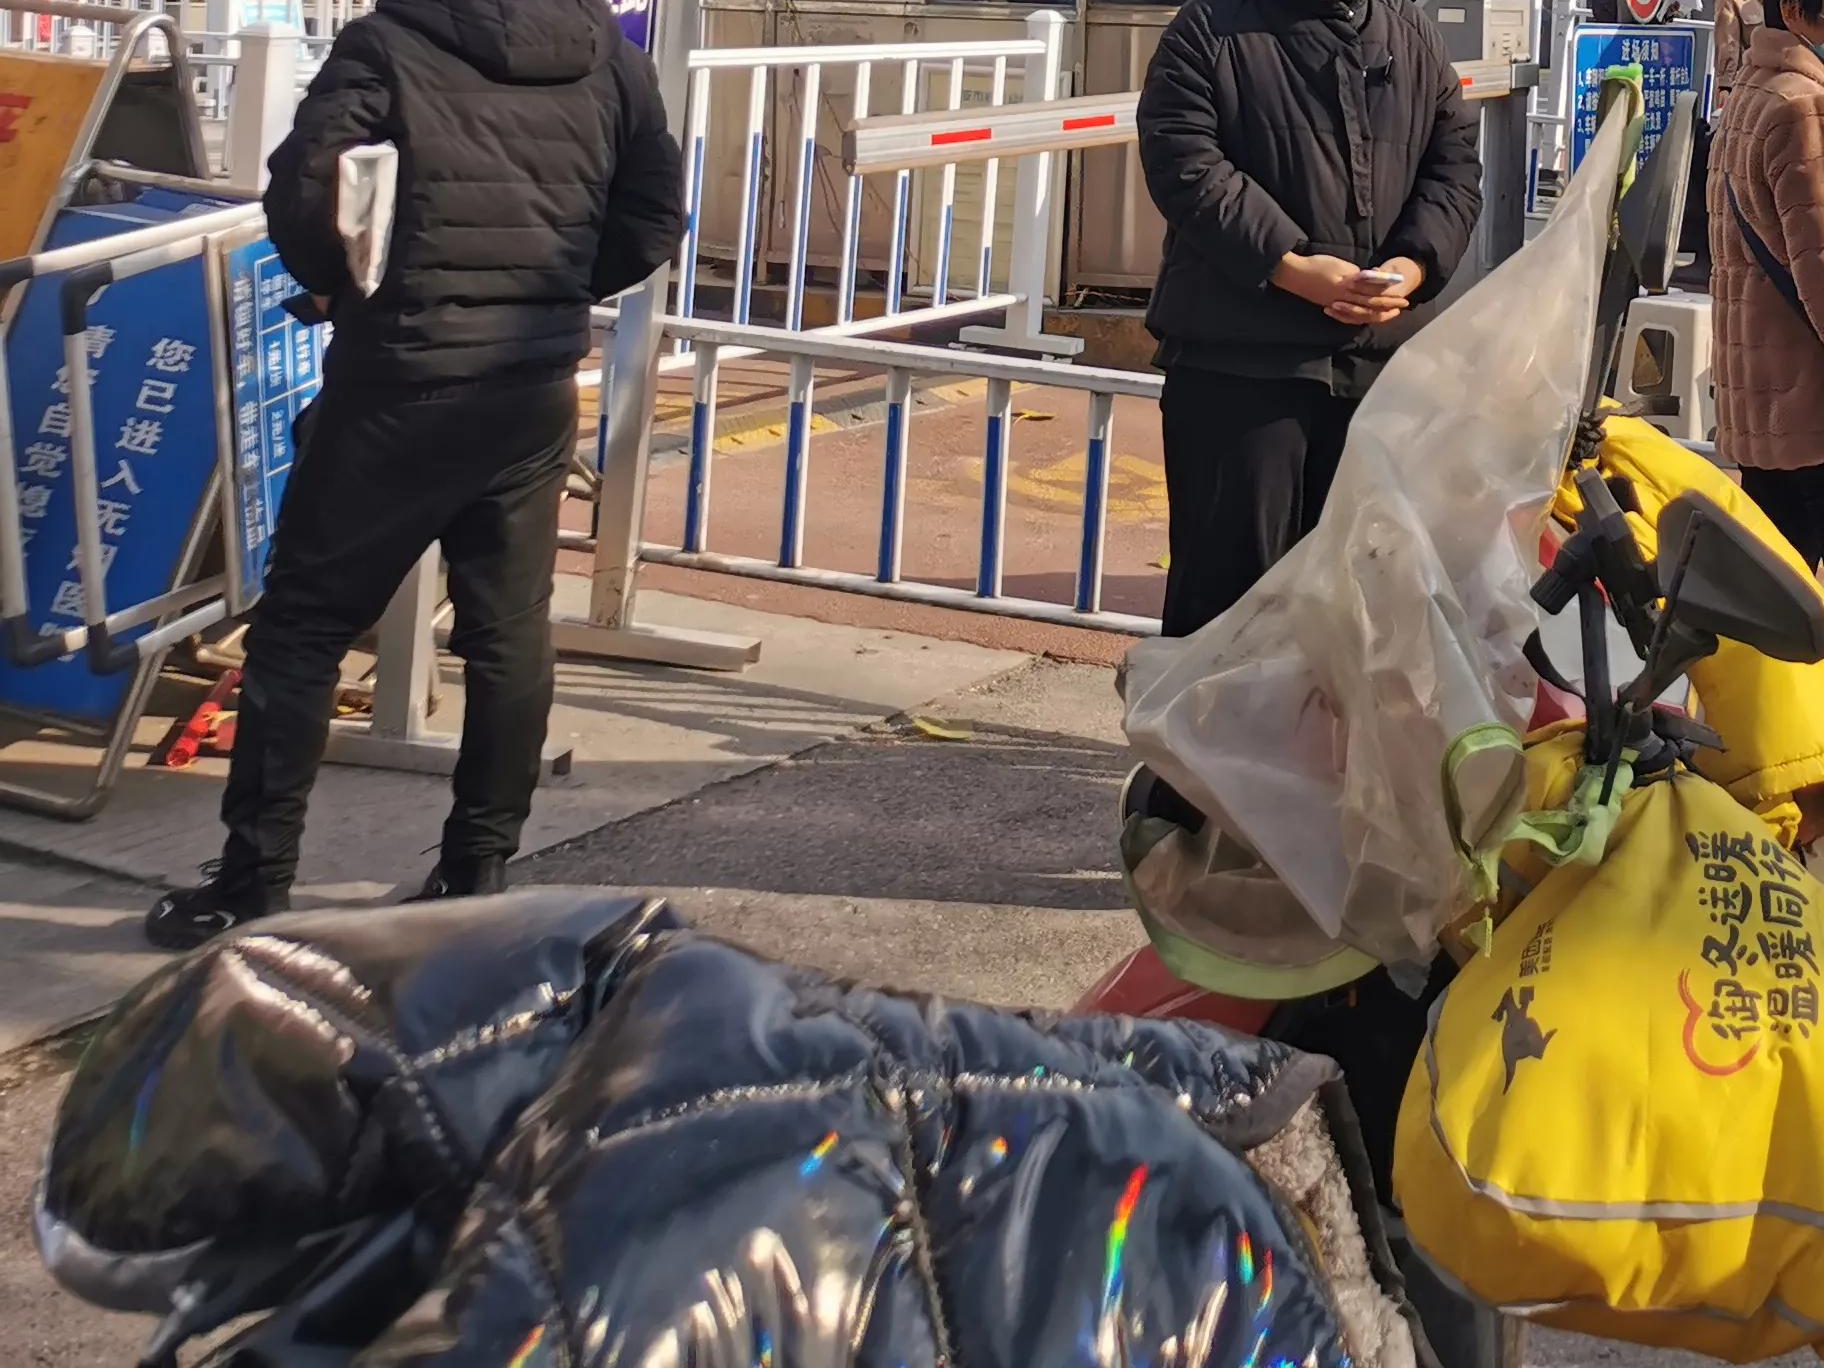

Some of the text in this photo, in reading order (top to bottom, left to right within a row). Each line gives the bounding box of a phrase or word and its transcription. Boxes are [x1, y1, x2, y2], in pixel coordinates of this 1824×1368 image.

[1685, 830, 1763, 1042] 御冬送暖
[1756, 838, 1822, 1040] 温暖同行
